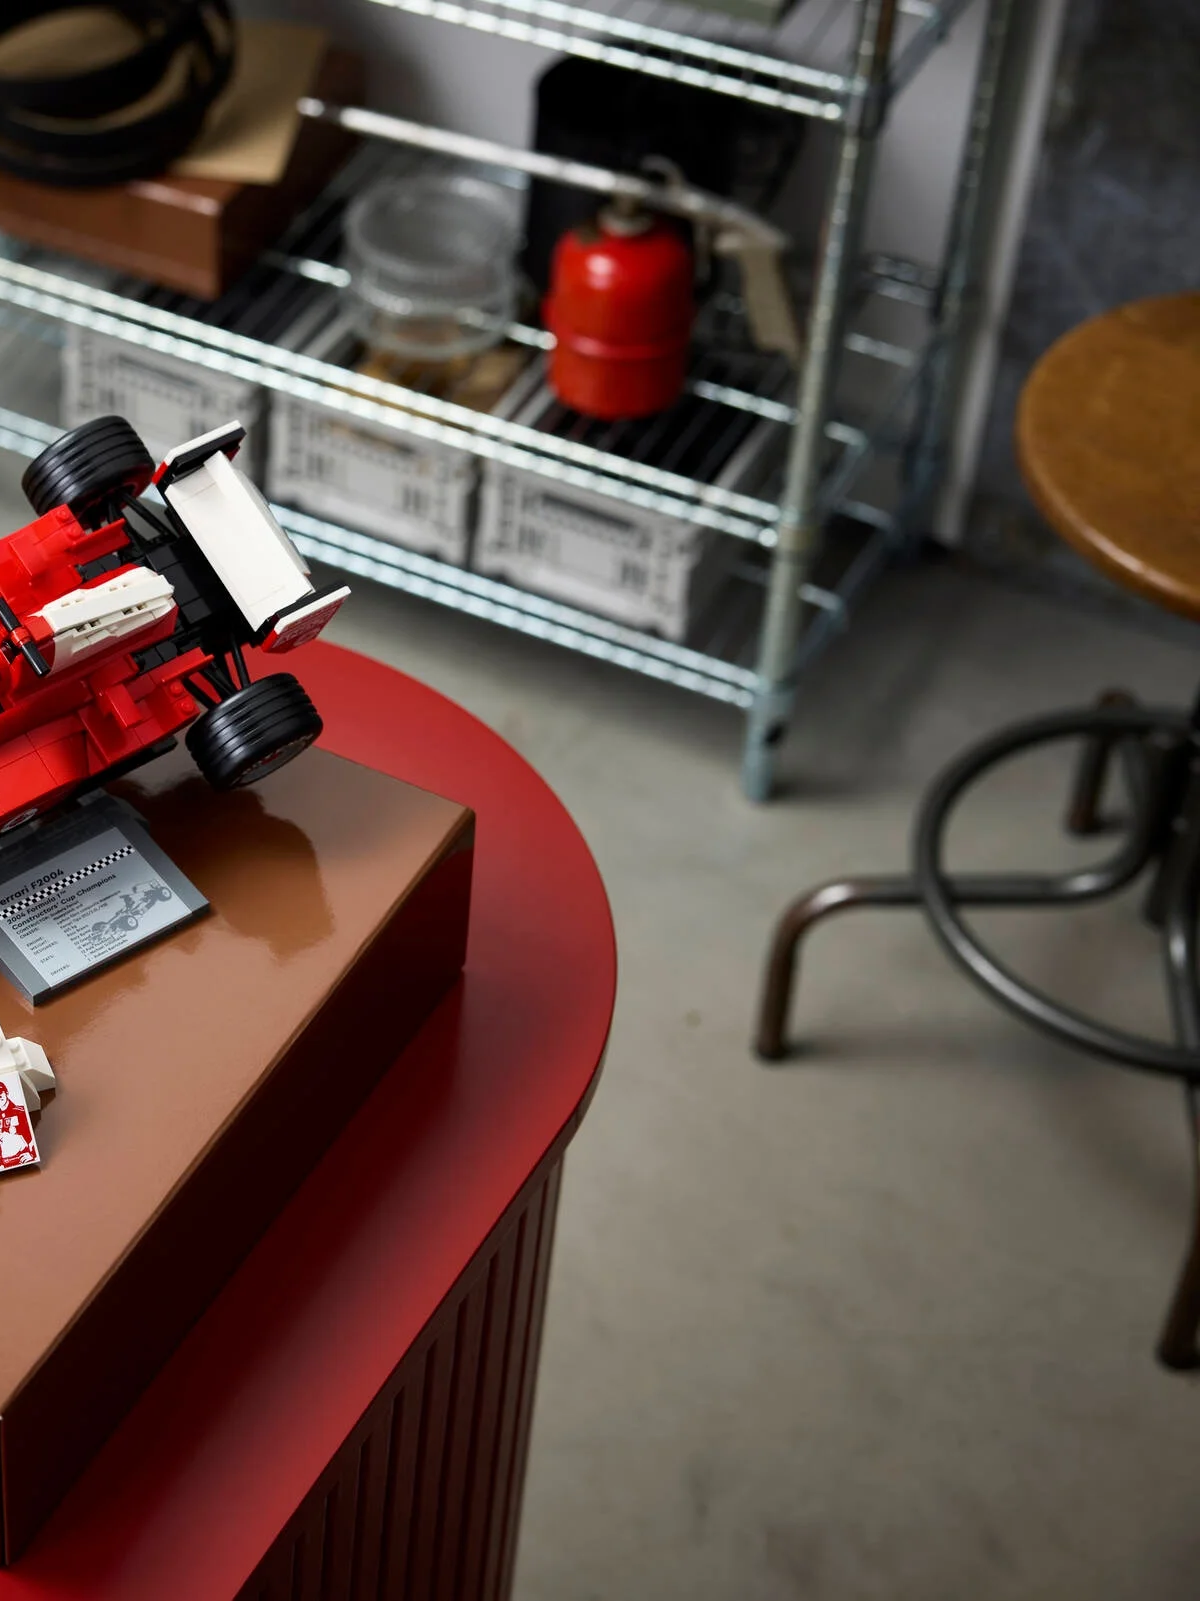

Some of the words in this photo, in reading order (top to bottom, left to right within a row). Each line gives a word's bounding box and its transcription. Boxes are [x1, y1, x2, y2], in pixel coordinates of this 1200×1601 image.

[30, 868, 65, 890] F2004
[6, 912, 26, 925] 2004
[26, 896, 56, 914] Formula
[11, 902, 60, 931] Constructors'
[60, 895, 76, 906] Cup
[76, 873, 117, 897] Champions
